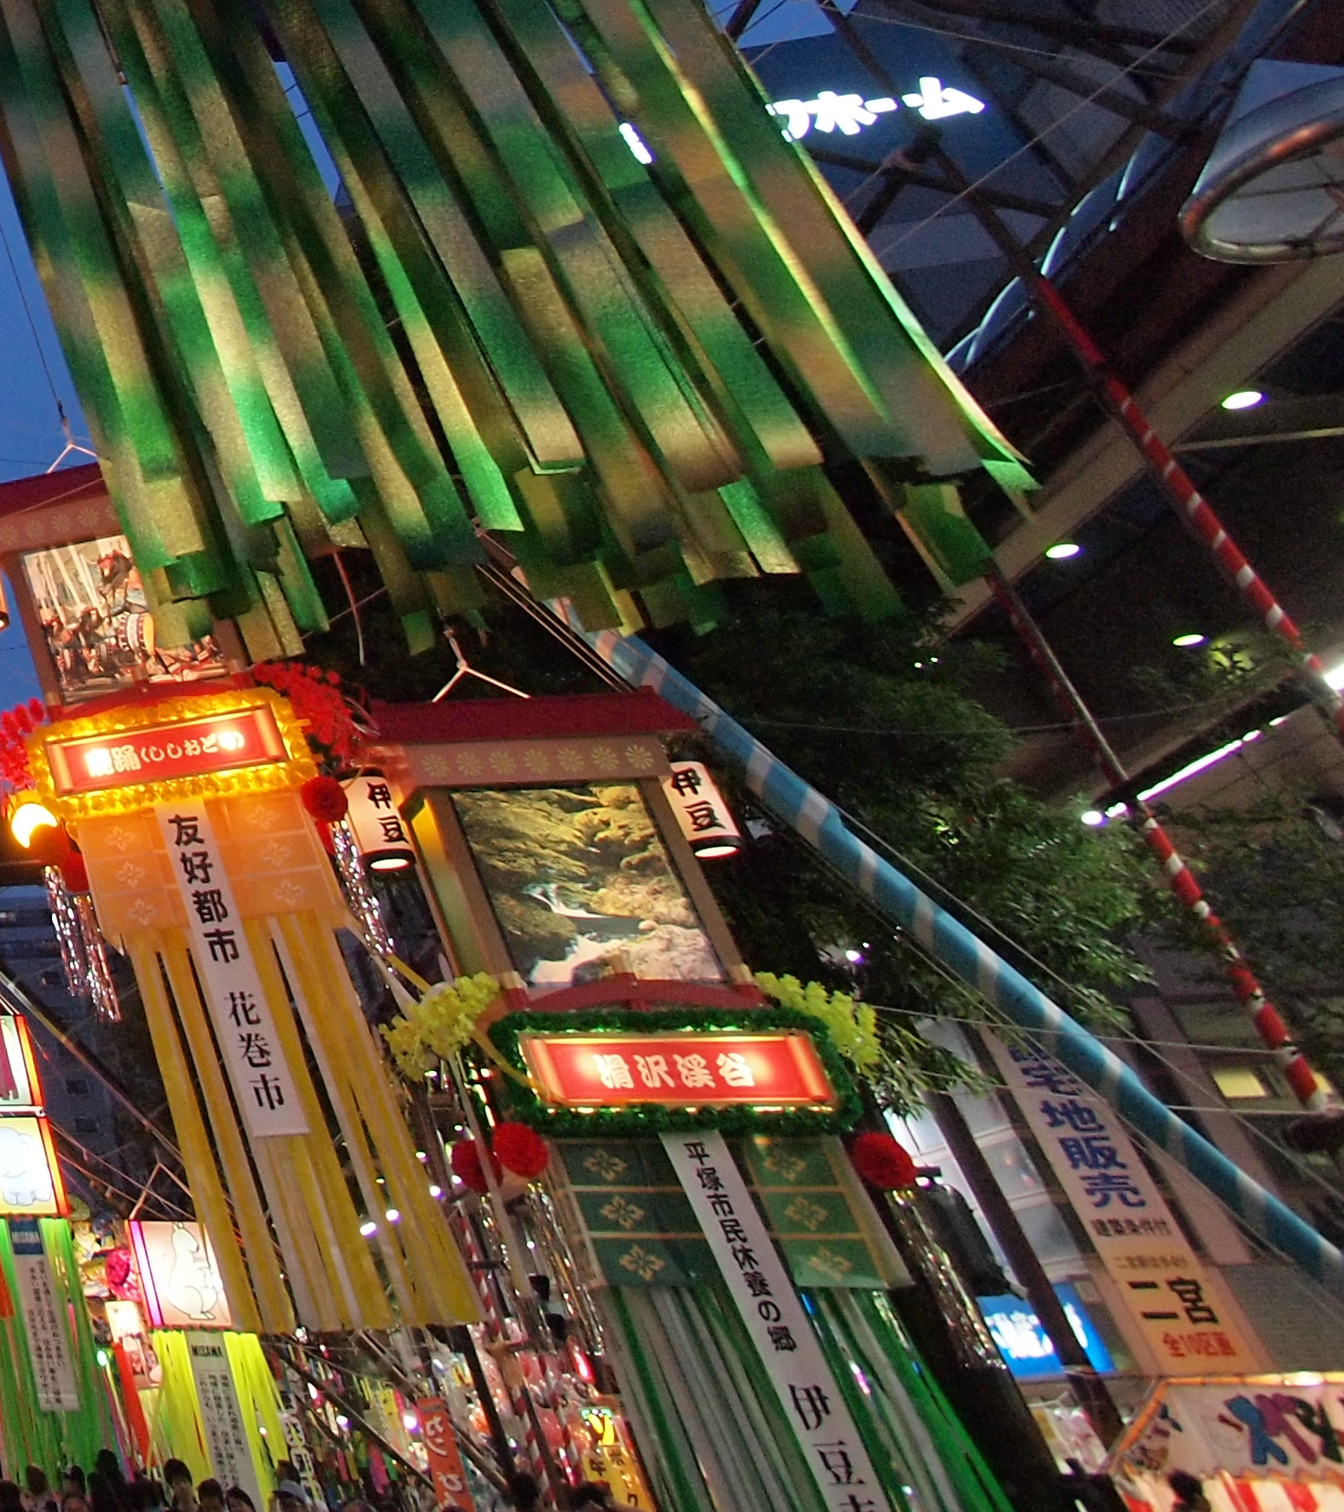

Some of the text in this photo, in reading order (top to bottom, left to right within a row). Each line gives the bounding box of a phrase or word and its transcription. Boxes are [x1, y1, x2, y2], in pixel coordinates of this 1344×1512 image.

[367, 781, 409, 844] 伊豆
[671, 767, 727, 832] 伊豆
[167, 814, 287, 1113] 友好都市 花巻市
[594, 1050, 757, 1091] 滑沢渓谷
[684, 1141, 798, 1354] 平塚市民休養の郷
